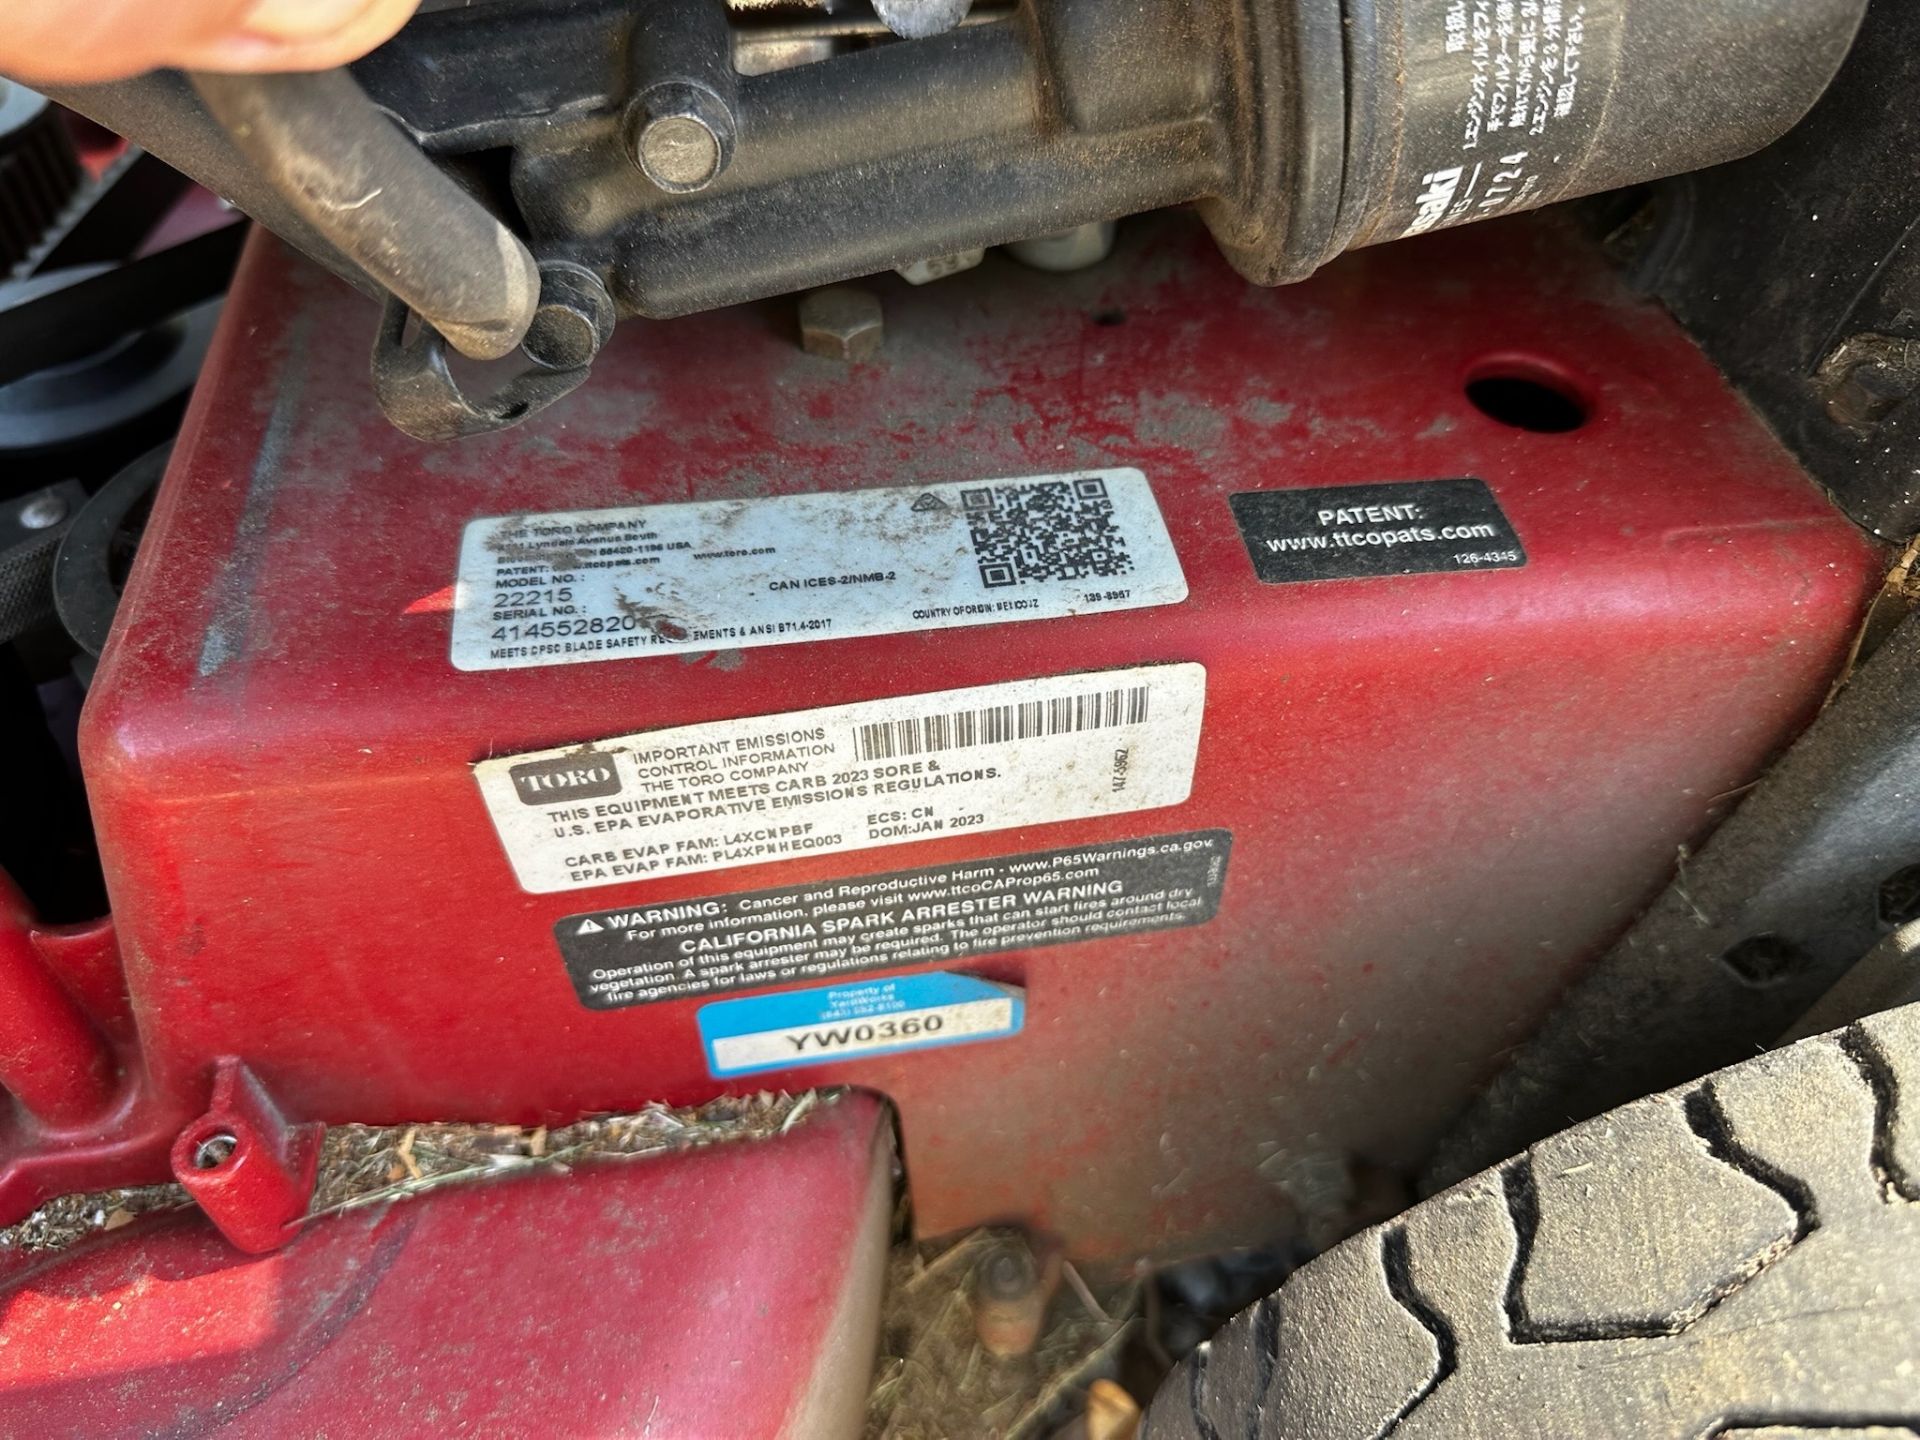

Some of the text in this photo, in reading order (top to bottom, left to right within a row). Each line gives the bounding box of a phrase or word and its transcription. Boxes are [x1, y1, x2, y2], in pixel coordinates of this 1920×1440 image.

[534, 526, 572, 536] TORO
[575, 520, 647, 534] COMPANY
[1316, 503, 1424, 527] PATENT:
[577, 534, 622, 546] Avenue
[624, 531, 658, 542] South
[666, 541, 692, 551] USA
[1265, 522, 1496, 553] www.ttcopats.com
[496, 565, 549, 577] PATENT:
[496, 576, 547, 589] MODEL
[769, 571, 897, 592] CAN ICES-2/NMB-2
[494, 587, 573, 609] 22215
[491, 614, 637, 642] 414552820
[493, 608, 548, 621] SERIAL
[490, 646, 528, 660] MEETS
[530, 643, 561, 656] CPSC
[565, 639, 603, 653] BLADE
[606, 635, 647, 649] SAFETY
[739, 629, 747, 637] &
[750, 624, 776, 635] ANSI
[633, 727, 825, 765] IMPORTANT EMISSIONS
[638, 743, 836, 779] CONTROL INFORMATION
[519, 766, 611, 793] TORO
[547, 759, 941, 823] THIS EQUIPMENT MEETS CARB 2023 SORE &
[641, 761, 809, 793] THE TORO COMPANY
[554, 767, 1001, 838] U.S. EPA EVAPORATIVE EMISSIONS REGULATIONS.
[867, 806, 934, 826] ECS: CN
[869, 814, 985, 840] DOM:JAN 2023
[565, 823, 814, 868] CARB EVAP FAM: L4XCNPBF
[571, 834, 843, 882] EPA EVAP FAM: PL4XPNHEQ003
[607, 901, 728, 930] WARNING:
[739, 893, 799, 911] Cancer
[803, 888, 834, 902] and
[838, 872, 947, 898] Reproductive
[951, 866, 995, 882] Harm
[626, 928, 656, 943] For
[660, 921, 705, 937] more
[812, 900, 866, 917] please
[870, 893, 904, 908] visit
[907, 867, 1100, 902] www.ttcoCAProp65.com
[679, 879, 1124, 956] CALIFORNIA SPARK ARRESTER WARNING
[591, 886, 1194, 982] Operation of this equipment may create sparks that can start fires around dry
[684, 968, 696, 980] A
[699, 962, 744, 978] spark
[748, 952, 811, 971] arrester
[813, 946, 848, 960] may
[851, 942, 871, 955] be
[874, 932, 944, 954] required.
[950, 927, 979, 941] The
[982, 917, 1047, 937] operator
[1050, 911, 1102, 927] should
[1106, 903, 1158, 919] contact
[1165, 896, 1202, 911] local
[606, 911, 1185, 1004] fire agencies for laws or regulations relating to fire prevention requirements.
[786, 1014, 944, 1051] YW0360
